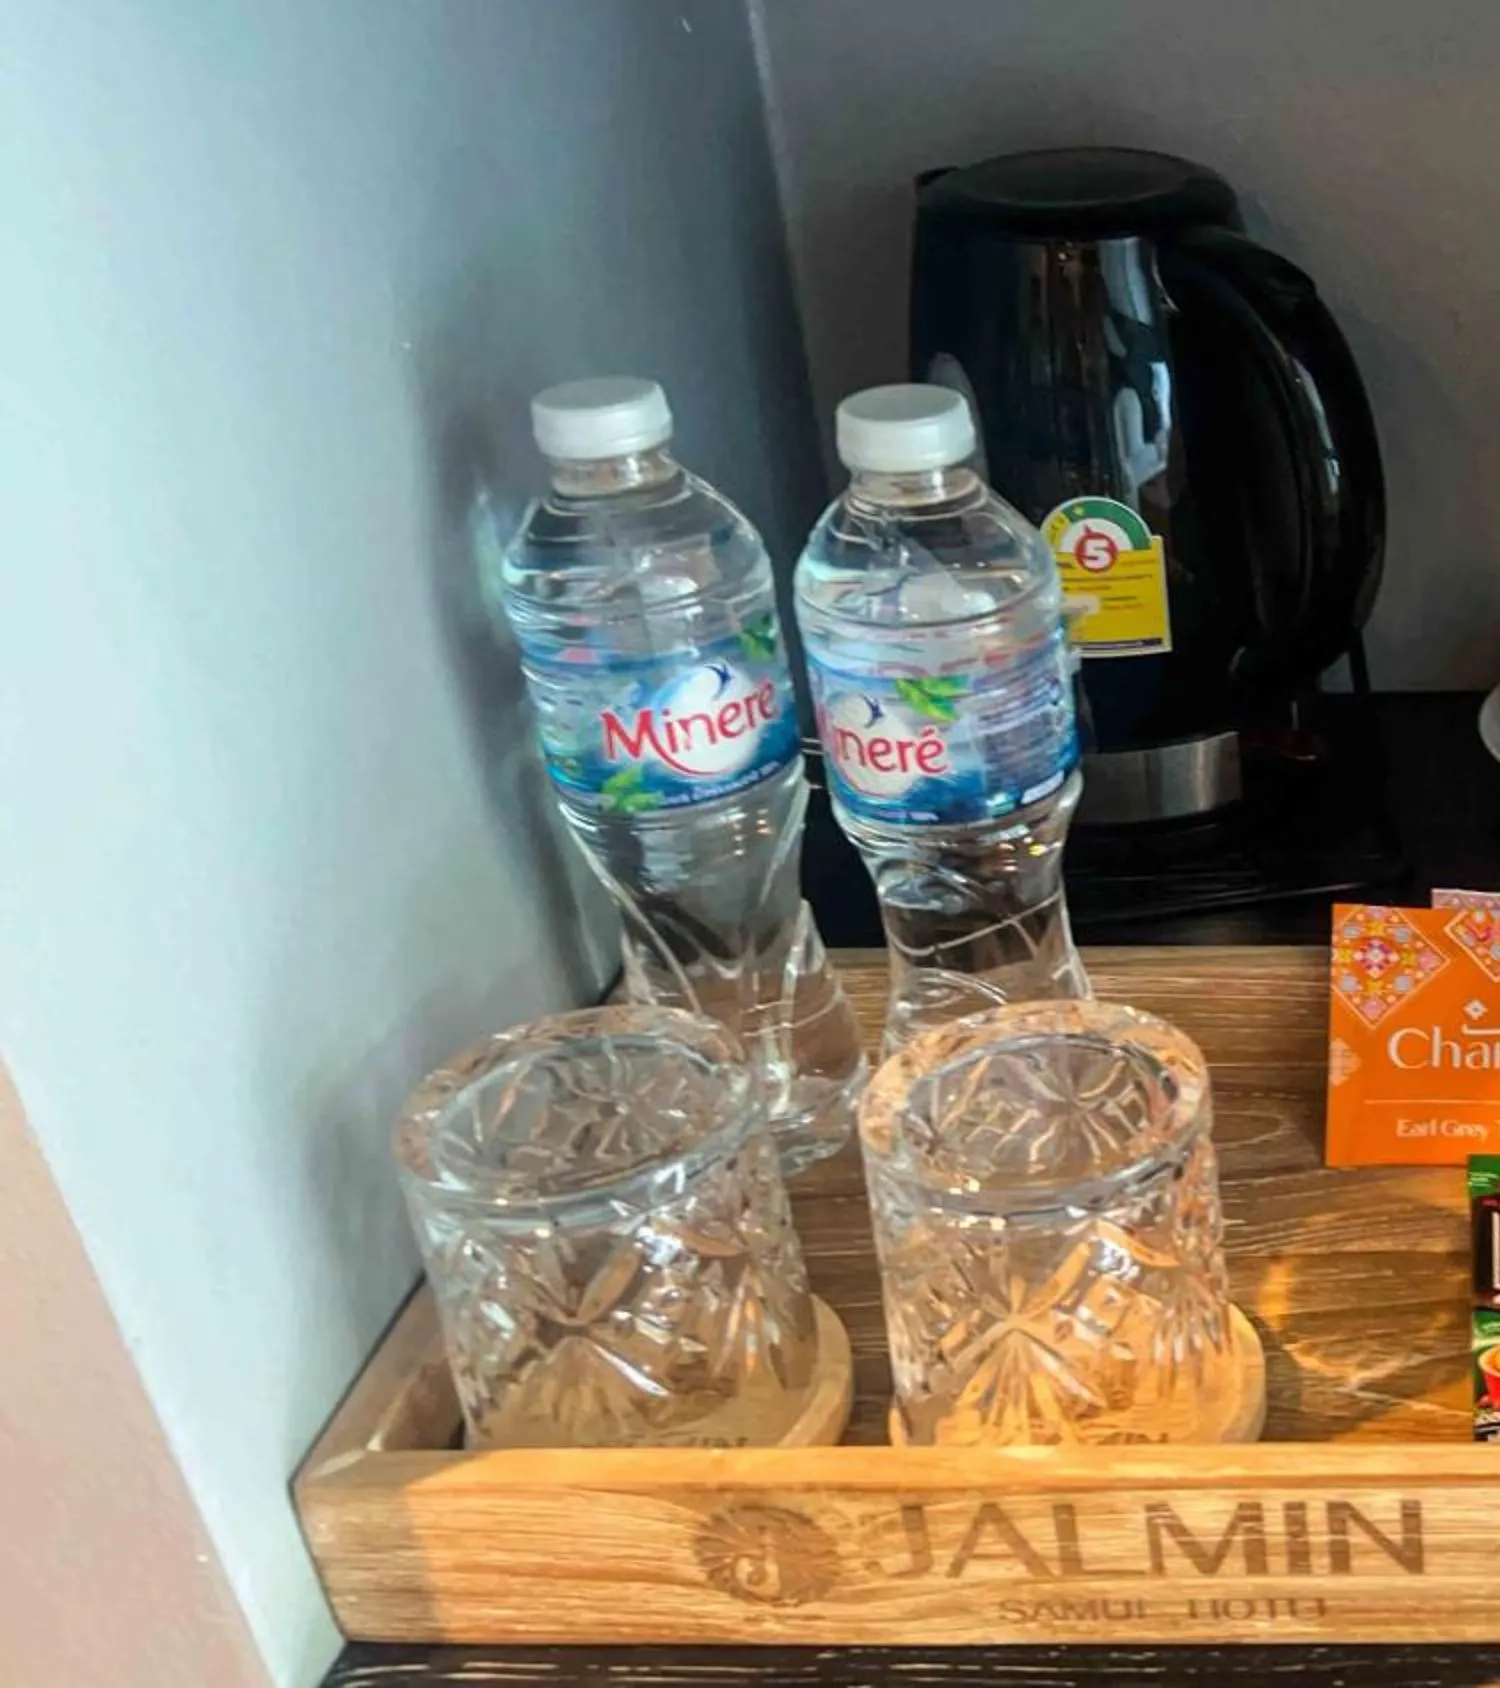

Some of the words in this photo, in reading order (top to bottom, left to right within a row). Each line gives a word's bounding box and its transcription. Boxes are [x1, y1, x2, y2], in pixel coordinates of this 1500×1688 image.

[1083, 537, 1112, 572] 5
[1396, 1119, 1436, 1138] Earl
[1440, 1119, 1488, 1143] Grey
[864, 1500, 1425, 1578] JALMIN
